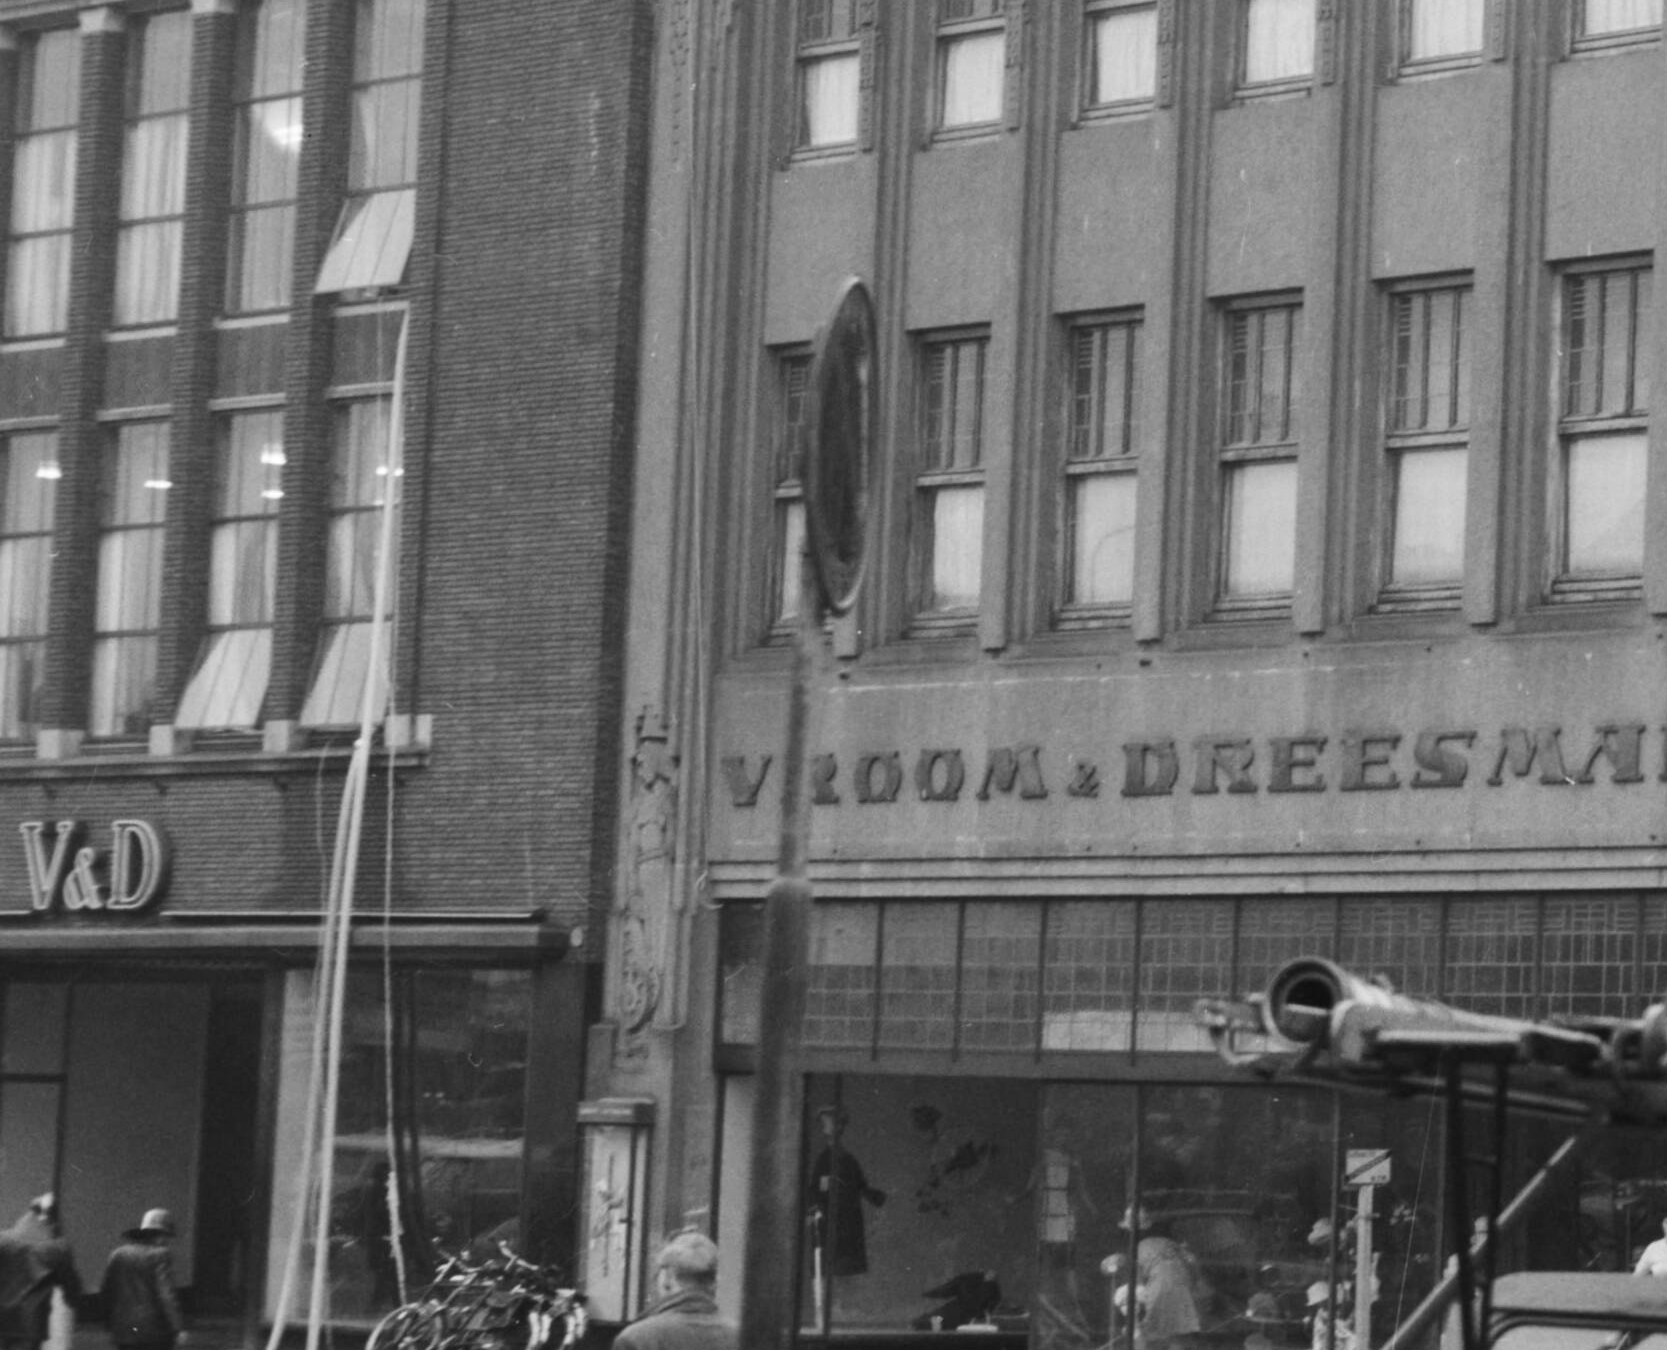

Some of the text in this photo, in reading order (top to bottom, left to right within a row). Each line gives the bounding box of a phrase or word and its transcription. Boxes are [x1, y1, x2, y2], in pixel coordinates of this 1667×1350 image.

[719, 746, 1050, 808] VROOM
[1067, 761, 1099, 800] &
[20, 819, 165, 911] V&D
